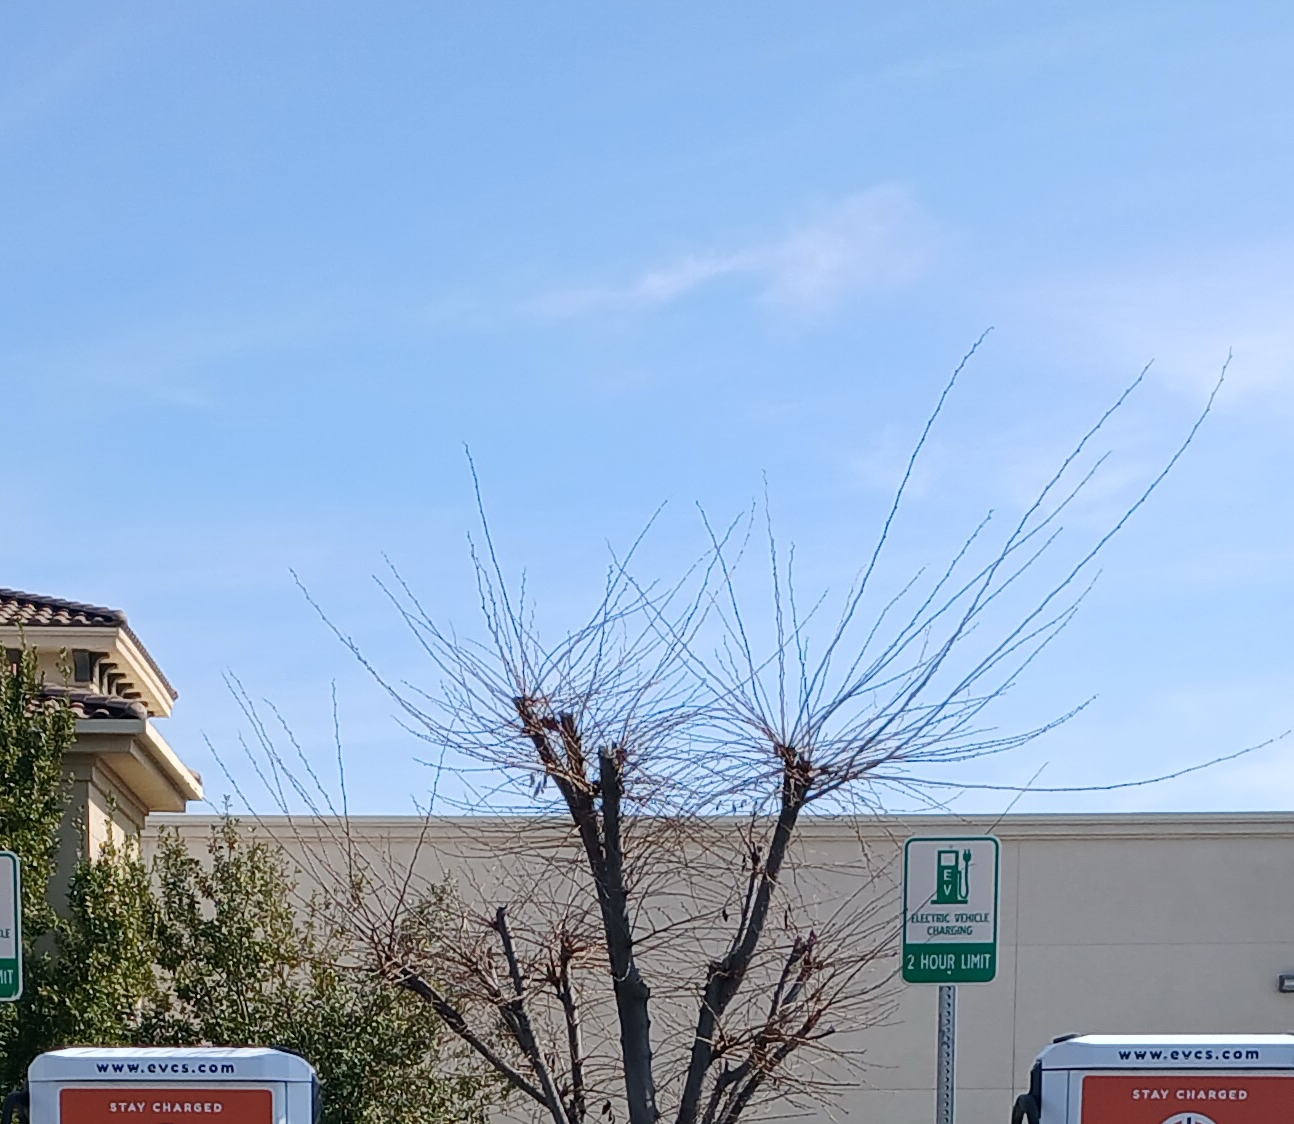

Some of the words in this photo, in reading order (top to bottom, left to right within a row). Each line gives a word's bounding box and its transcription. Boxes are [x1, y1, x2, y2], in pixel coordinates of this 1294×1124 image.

[911, 913, 949, 923] ELECTRIC
[954, 913, 990, 923] VEHICLE
[927, 925, 973, 935] CHARGING
[907, 954, 915, 969] 2
[920, 953, 956, 969] HOUR
[961, 953, 991, 969] LIMIT
[1118, 1049, 1259, 1060] www.evcs.com
[96, 1062, 235, 1074] www.evcs.com
[1132, 1089, 1169, 1100] STAY
[1176, 1089, 1248, 1100] CHARGED
[109, 1102, 146, 1112] STAY
[152, 1102, 222, 1113] CHARGED
